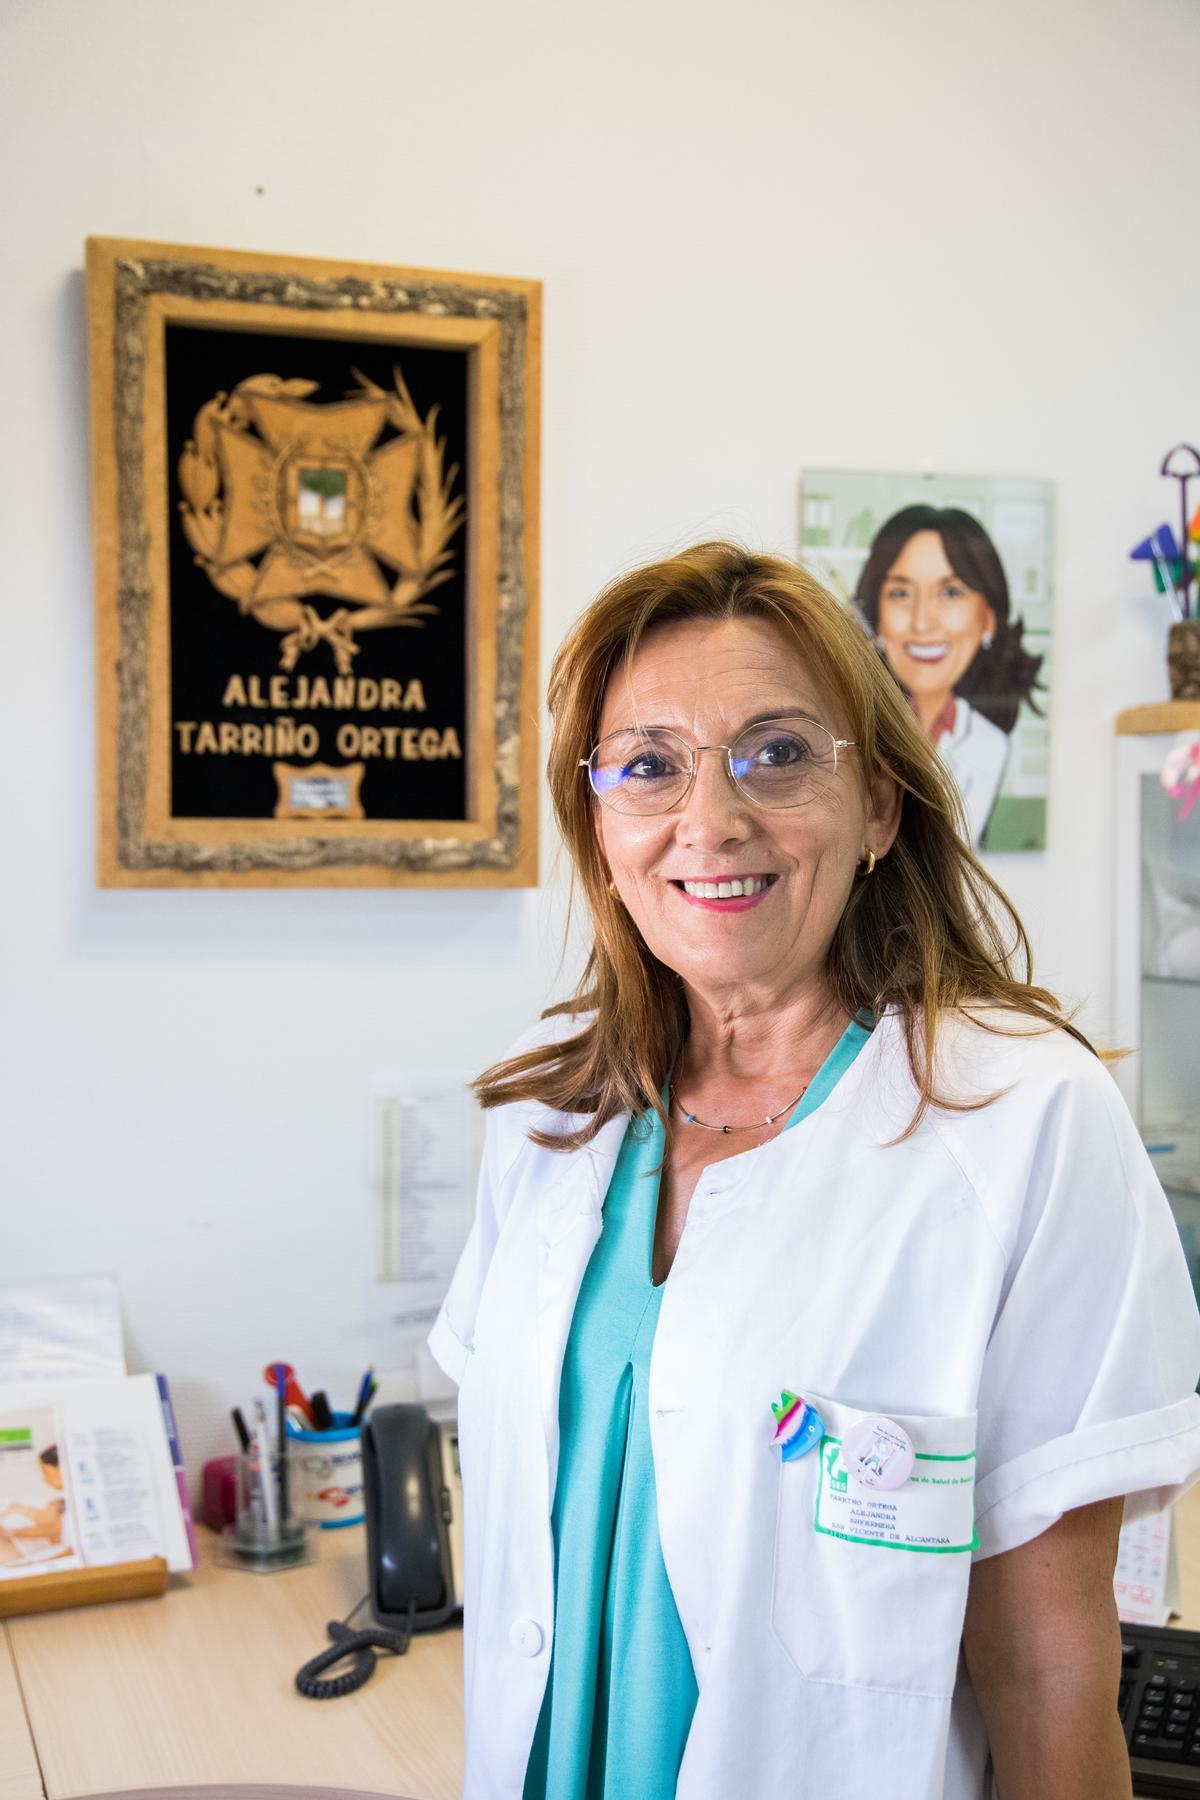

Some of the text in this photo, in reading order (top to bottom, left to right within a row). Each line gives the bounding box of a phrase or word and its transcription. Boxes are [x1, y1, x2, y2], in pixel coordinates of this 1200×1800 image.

[222, 674, 427, 711] ALEJANDRA
[174, 717, 462, 761] TARRIÑO ORTEGA
[831, 1477, 846, 1491] SES
[867, 1501, 898, 1512] ORTEGA
[850, 1508, 897, 1521] ALEJANDRA
[831, 1522, 845, 1531] SAN
[849, 1527, 885, 1538] VICENTE
[889, 1532, 901, 1540] DE
[850, 1518, 896, 1531] ENFERMERA
